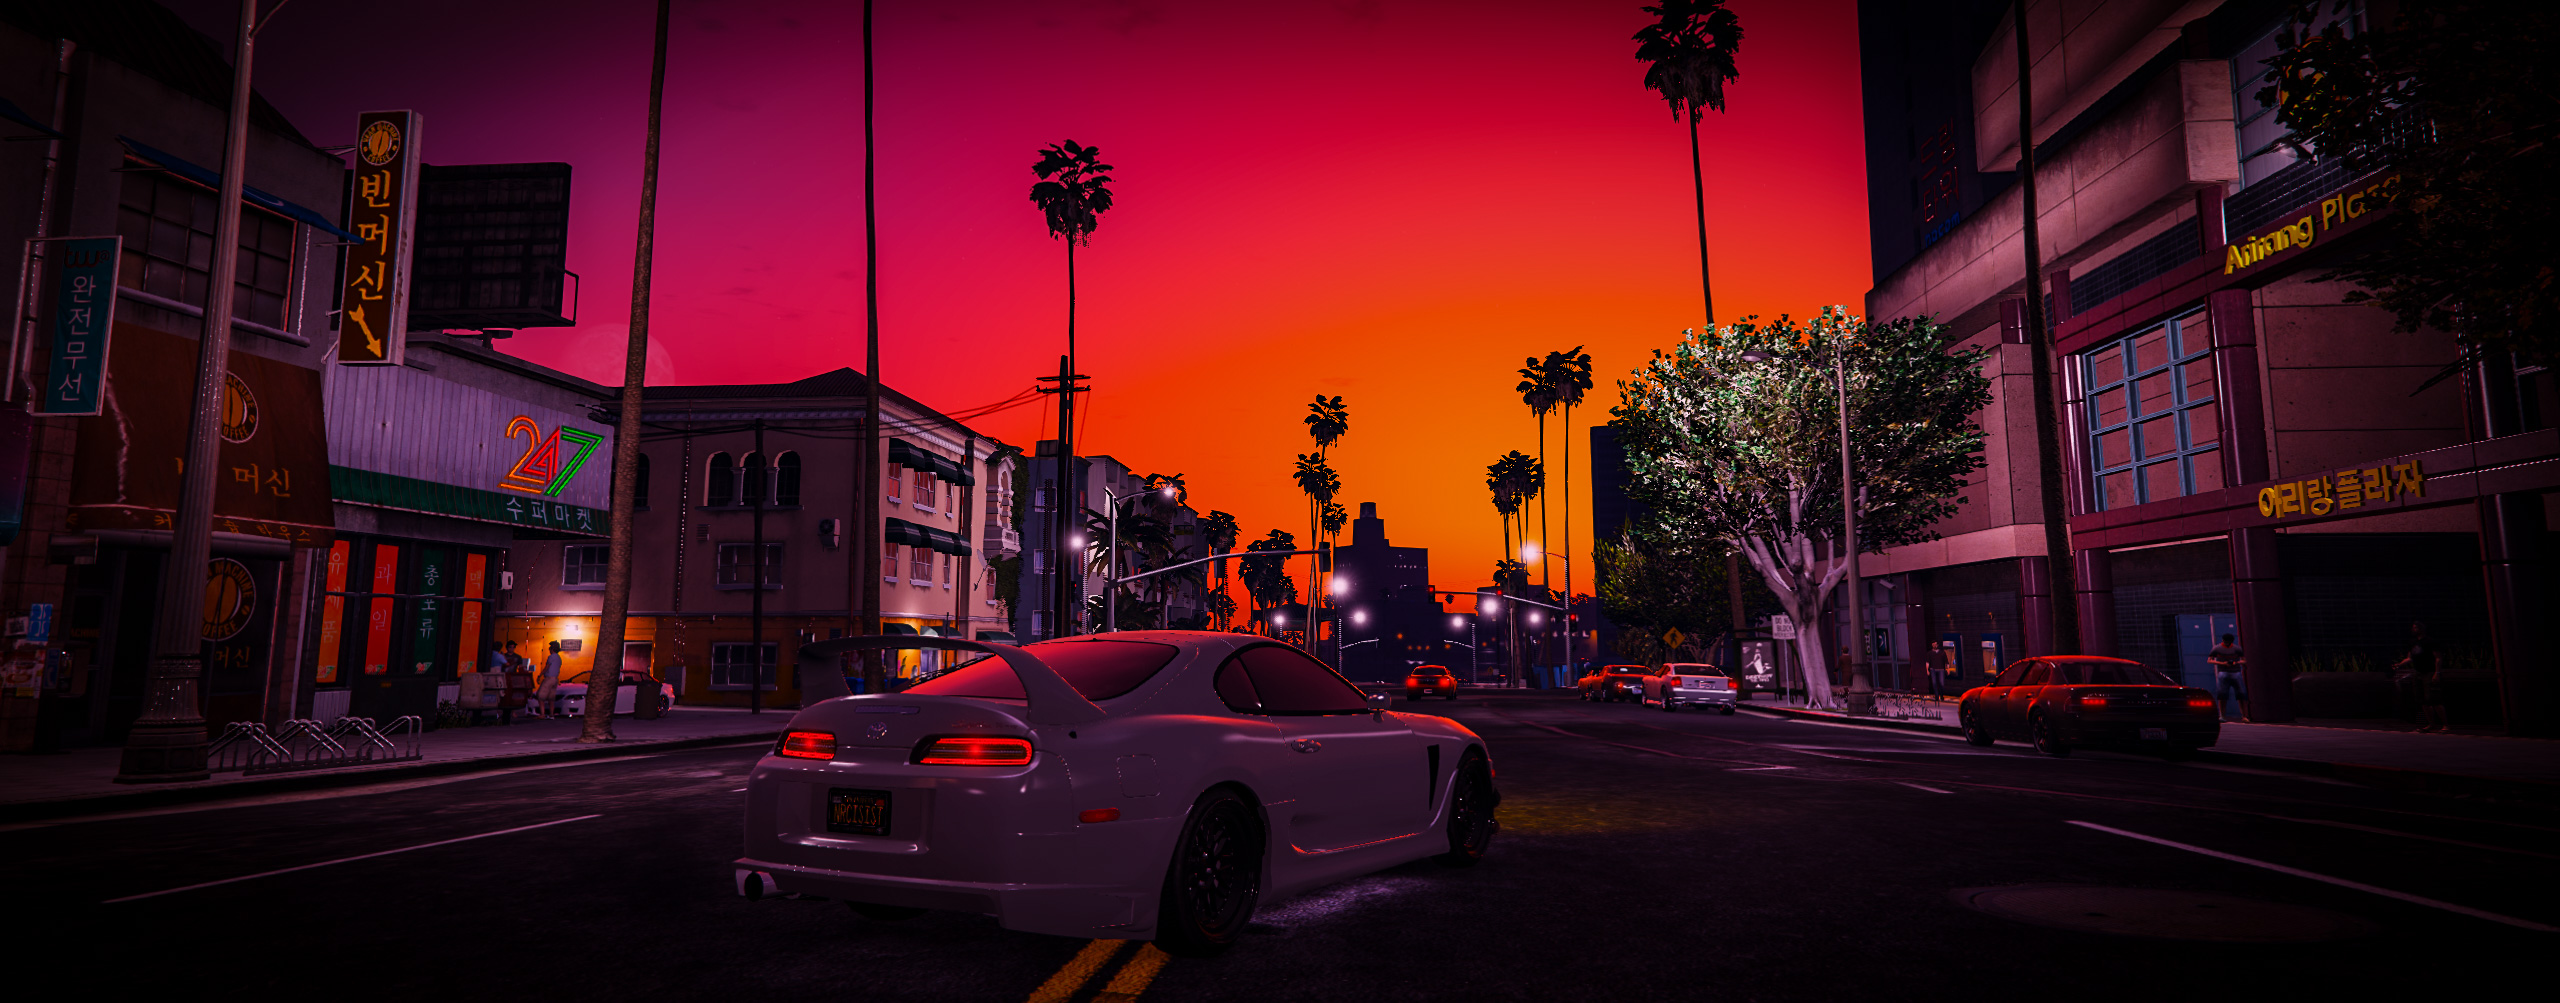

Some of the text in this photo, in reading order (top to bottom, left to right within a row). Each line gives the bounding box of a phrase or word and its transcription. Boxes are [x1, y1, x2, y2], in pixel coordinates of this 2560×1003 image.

[351, 169, 391, 301] 빈머신
[2224, 214, 2315, 276] Arirang
[58, 274, 97, 402] 완전무선
[225, 375, 254, 409] ACHINE
[221, 424, 249, 440] OFFEE
[506, 497, 592, 531] 수퍼마켓
[2258, 459, 2427, 518] 아리랑플라자
[372, 563, 392, 632] 과일
[200, 620, 239, 639] OFFEE
